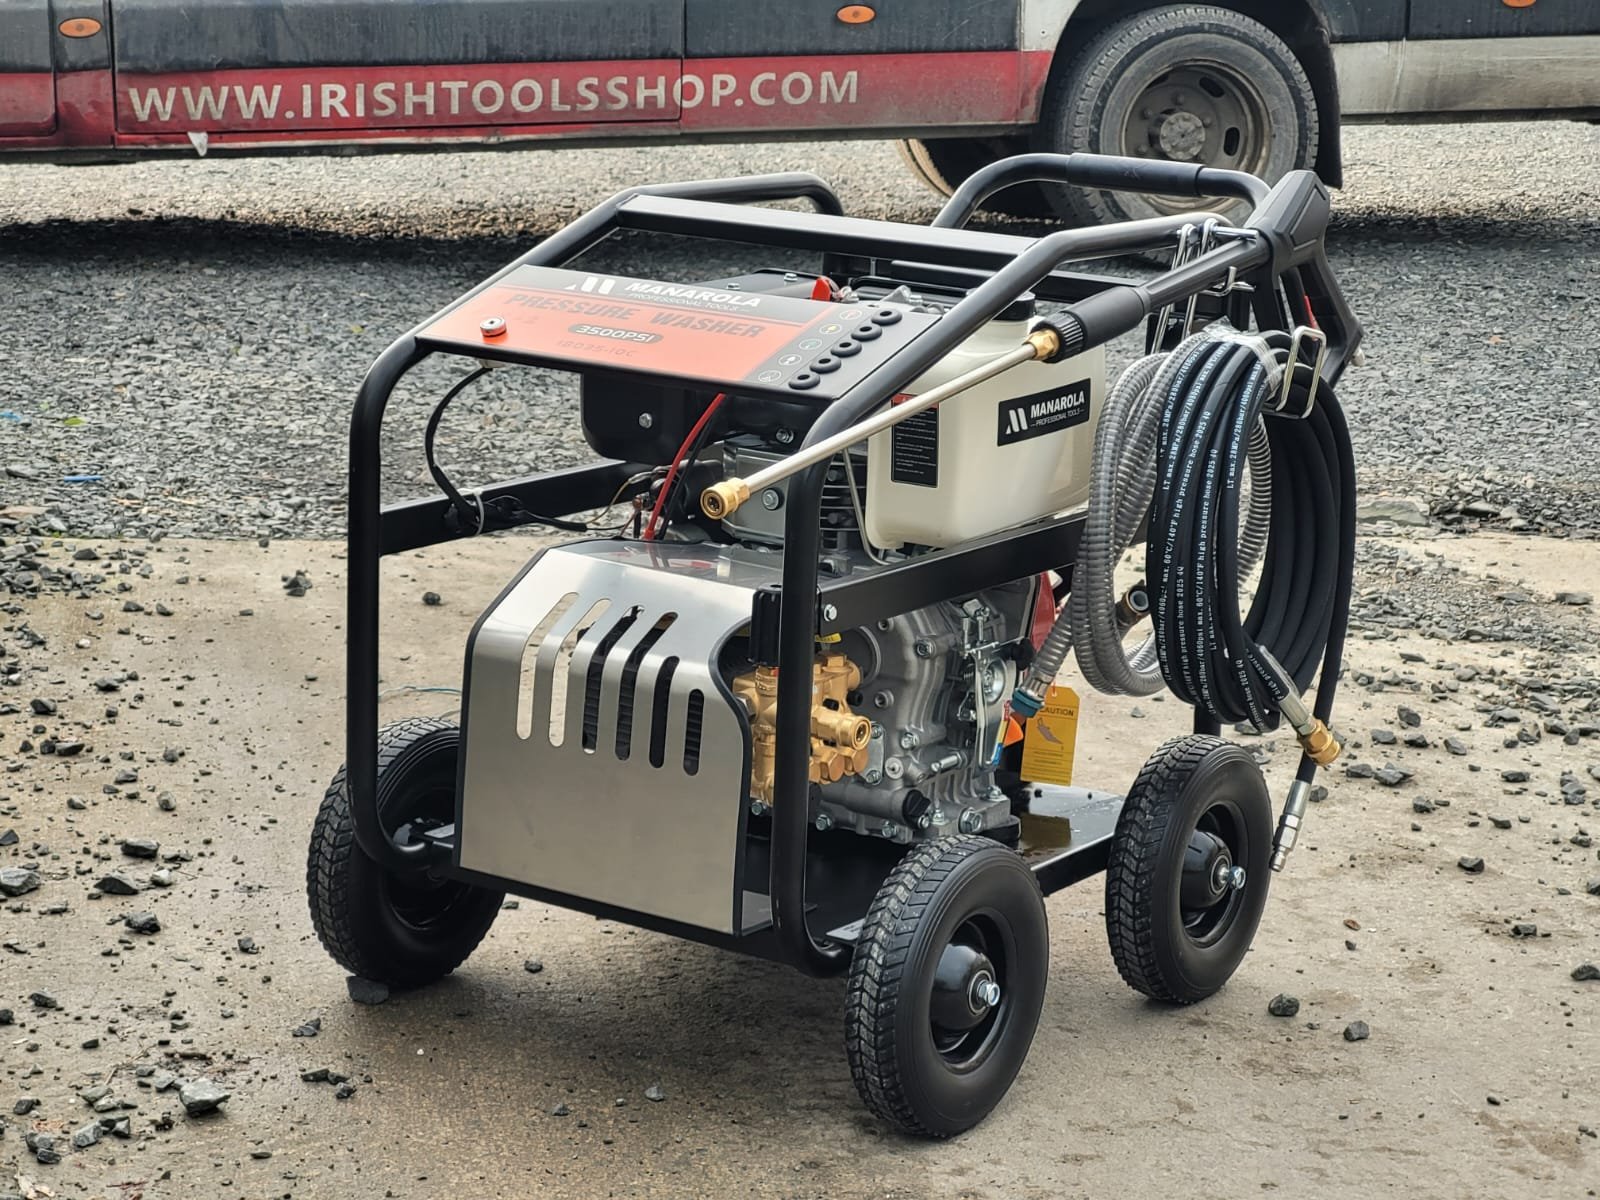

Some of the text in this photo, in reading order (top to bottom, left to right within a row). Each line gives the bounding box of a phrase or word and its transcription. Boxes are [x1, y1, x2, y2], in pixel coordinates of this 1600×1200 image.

[128, 70, 858, 122] WWW.IRISHTOOLSSHOP.COM
[624, 282, 760, 307] MANAROLA
[504, 294, 641, 321] PRESSURE
[650, 310, 766, 339] WASHER
[575, 325, 656, 343] 3500PSI
[1030, 391, 1085, 419] MANAROLA
[1173, 498, 1184, 518] high
[1179, 459, 1194, 496] pressure
[1190, 438, 1201, 458] hose
[1197, 418, 1208, 439] 2025
[1206, 459, 1217, 480] 2025
[1203, 480, 1213, 500] hose
[1226, 479, 1234, 489] LT
[1200, 500, 1210, 539] pressure
[1198, 541, 1207, 561] high
[1176, 578, 1184, 598] 2025
[1176, 600, 1185, 619] hose
